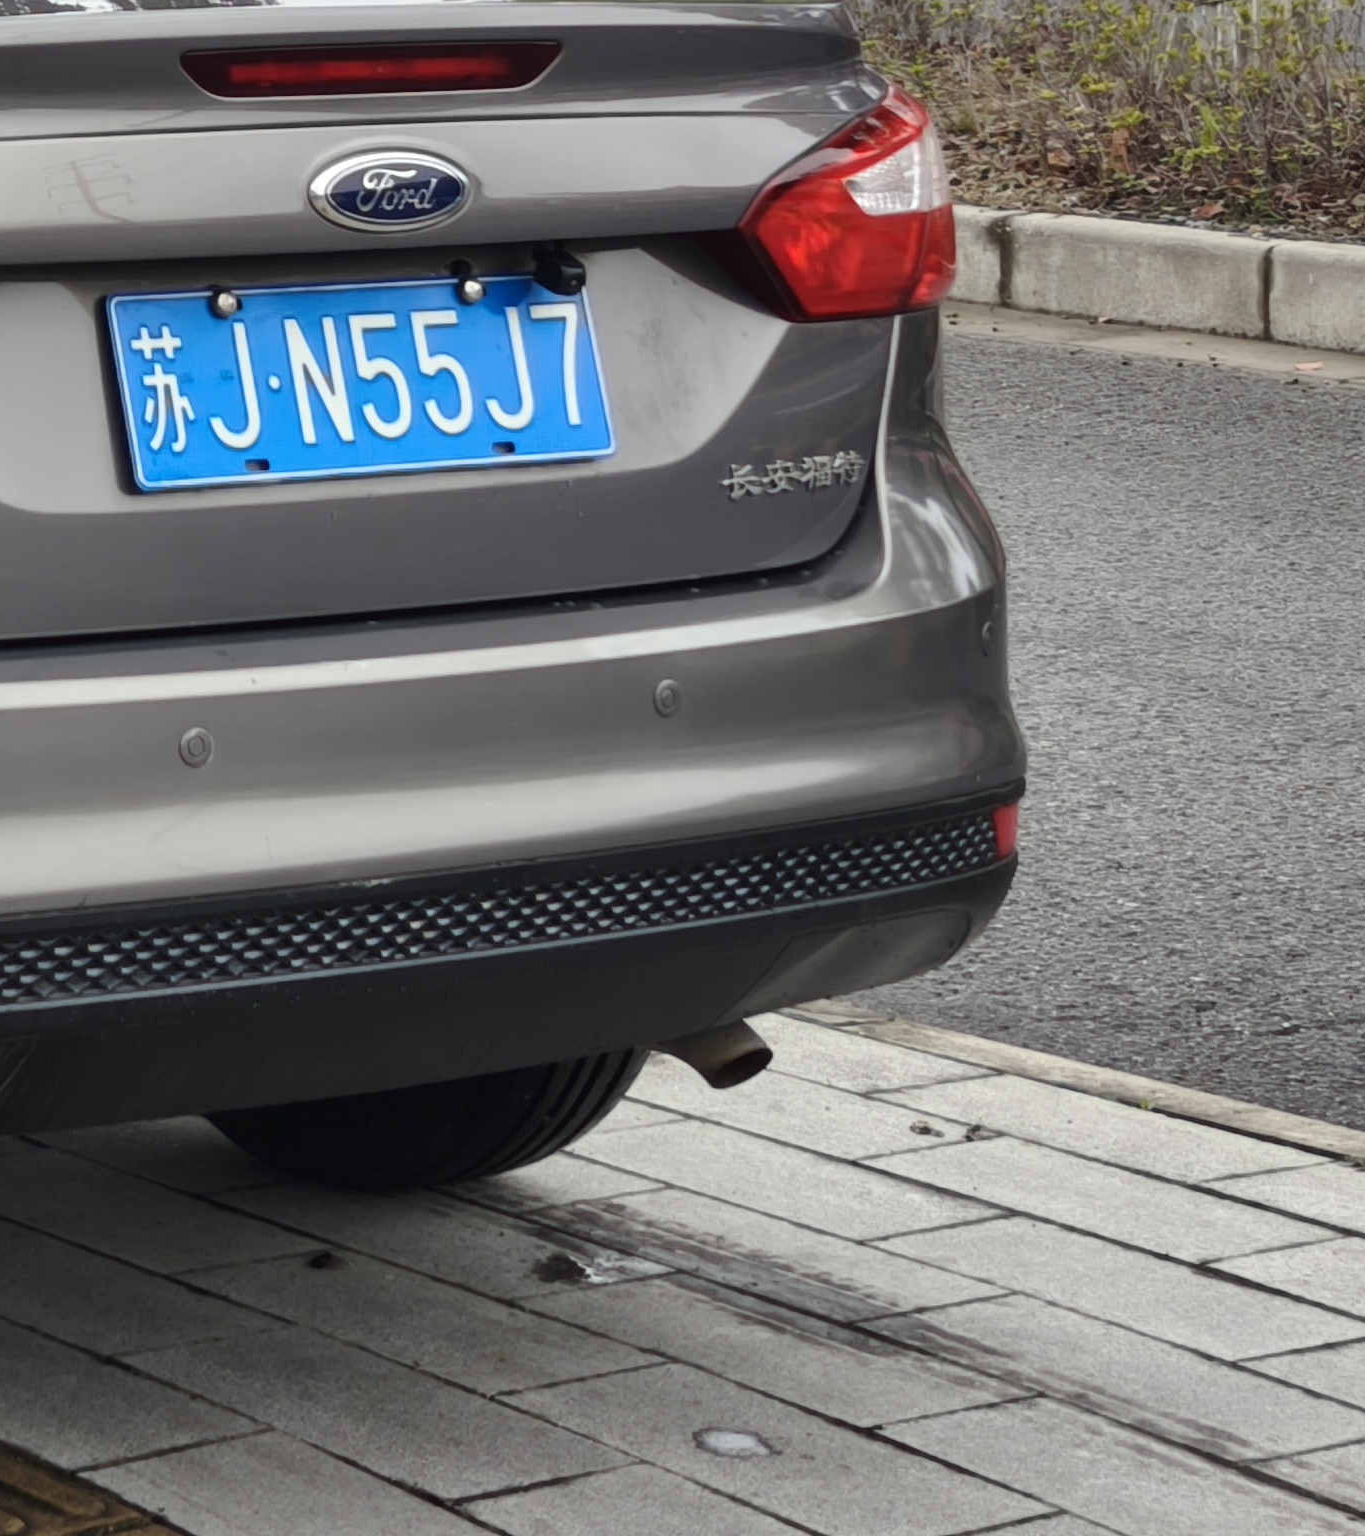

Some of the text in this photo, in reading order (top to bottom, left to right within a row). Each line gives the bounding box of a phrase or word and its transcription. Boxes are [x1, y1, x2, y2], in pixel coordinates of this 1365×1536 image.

[355, 168, 440, 213] Ford
[720, 449, 866, 501] 长安福特
